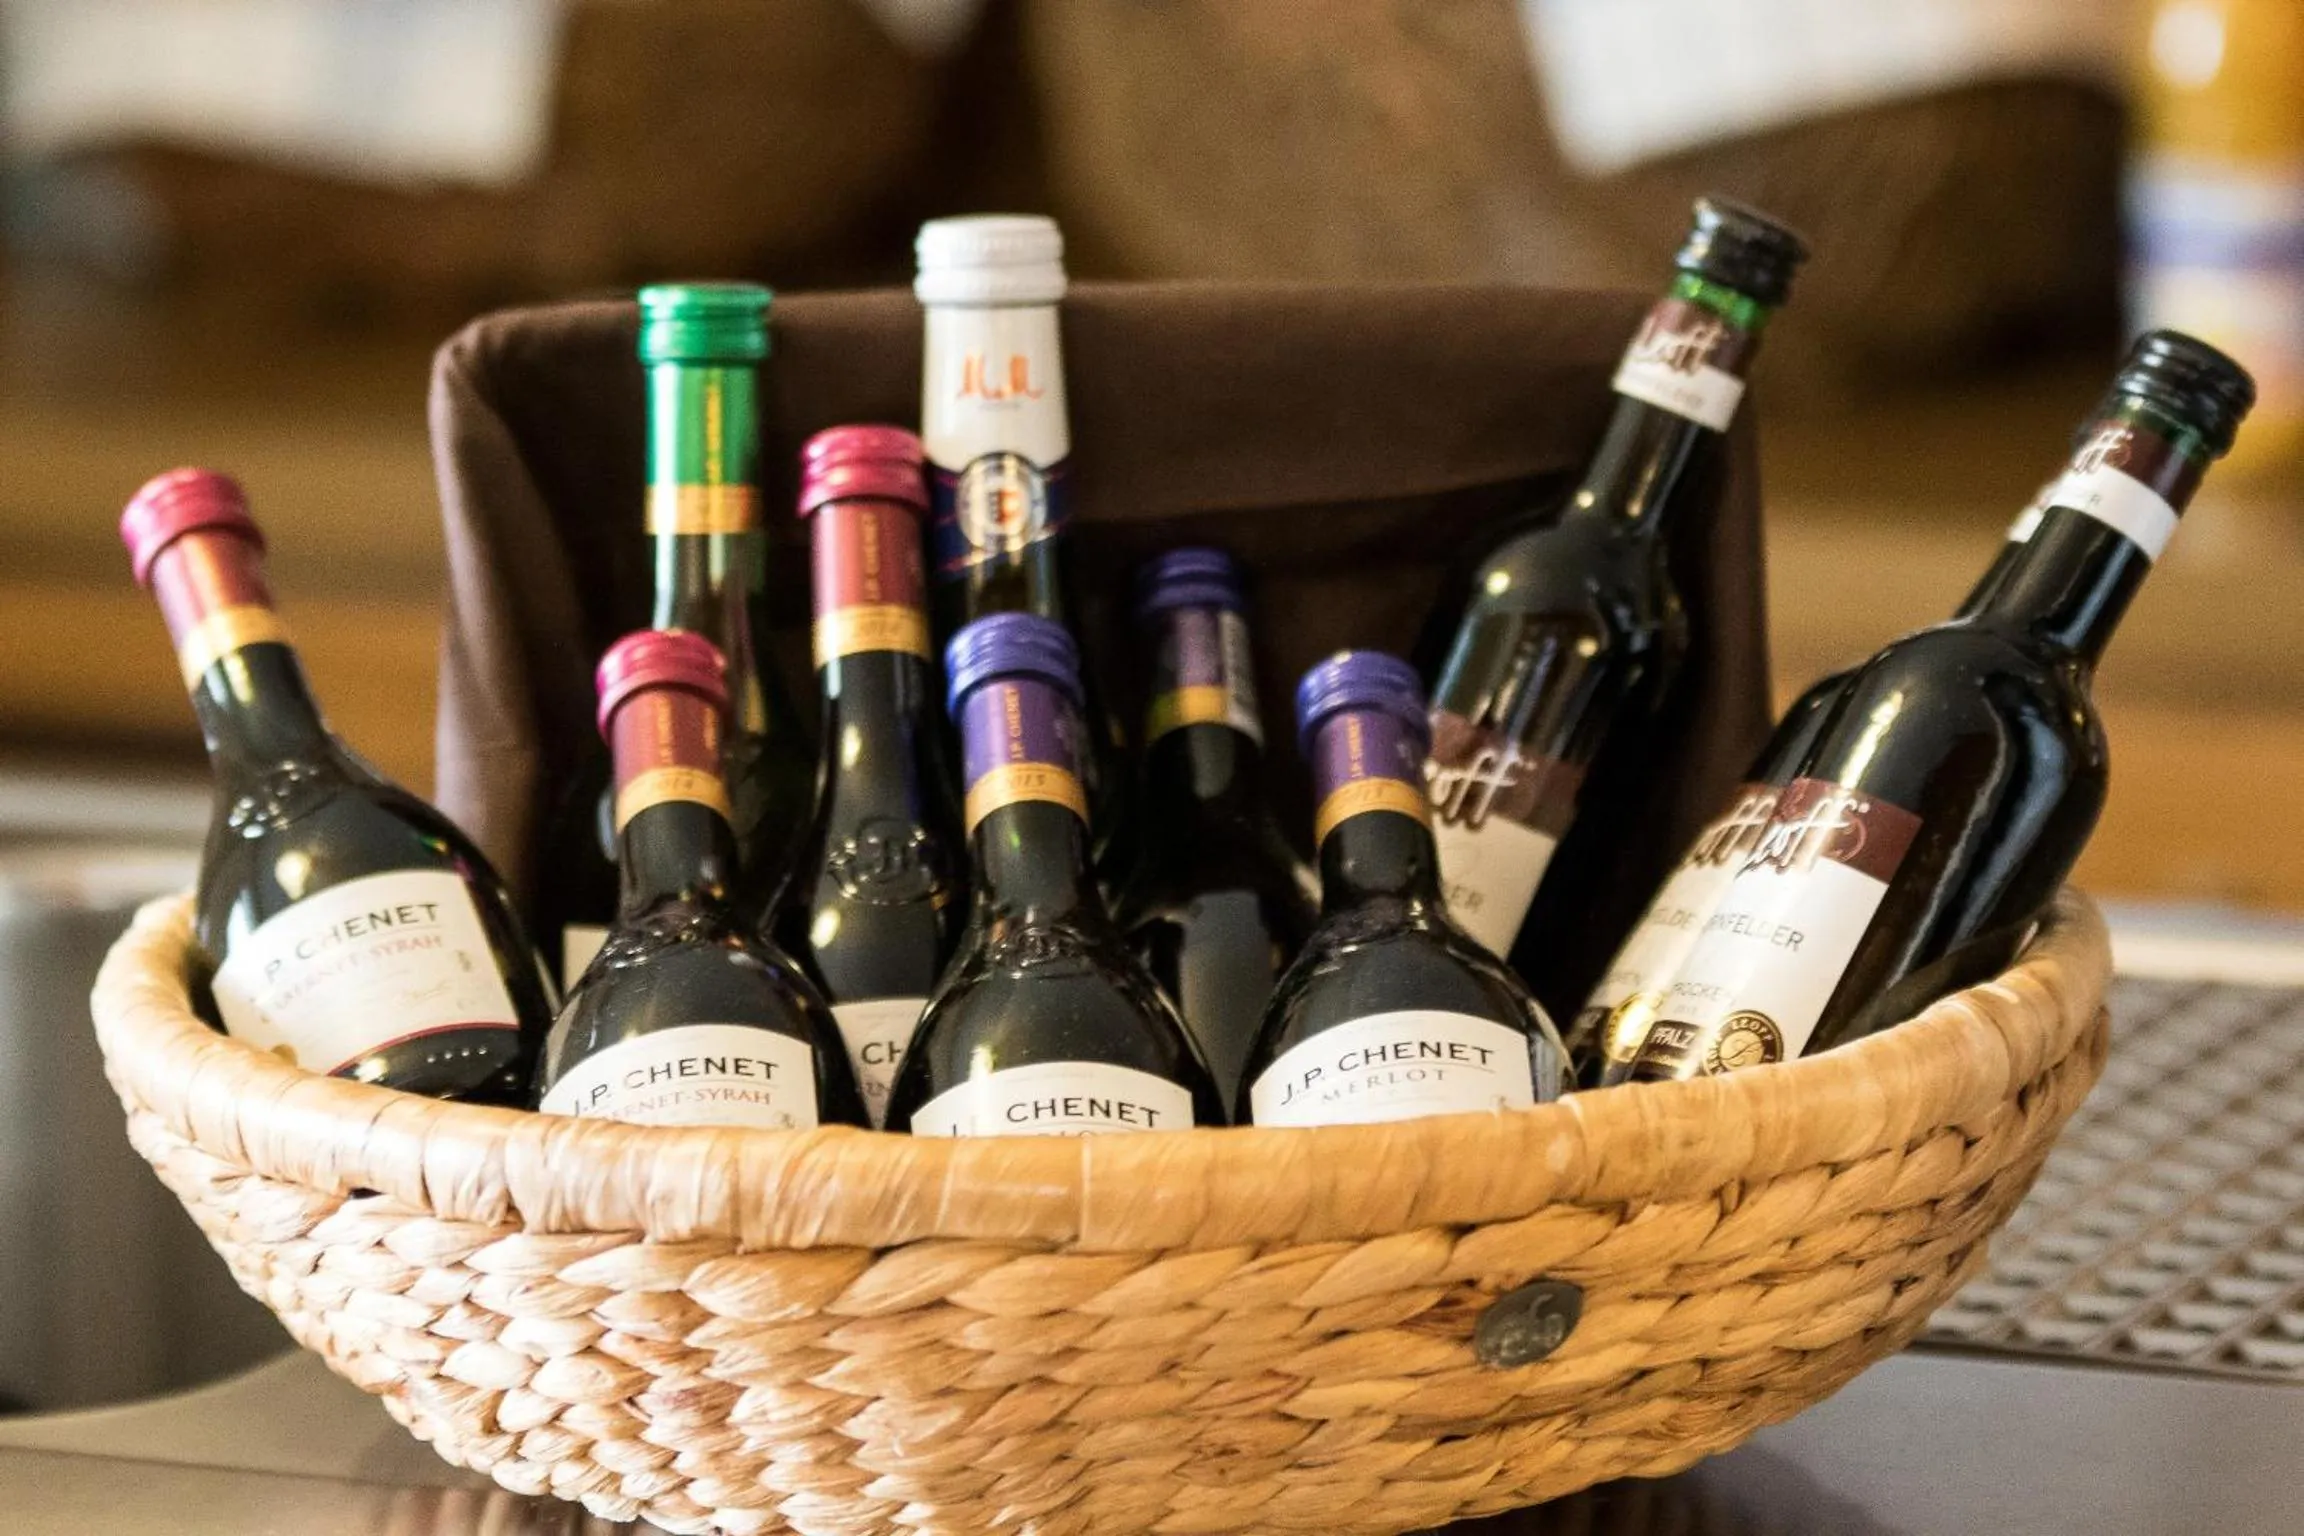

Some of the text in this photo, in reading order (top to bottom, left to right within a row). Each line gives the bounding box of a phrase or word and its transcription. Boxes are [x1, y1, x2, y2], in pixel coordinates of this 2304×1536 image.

[295, 902, 440, 961] CHENET
[622, 1056, 780, 1091] CHENET
[1280, 1041, 1496, 1106] J.P. CHENET
[1321, 1067, 1448, 1102] MERLOT
[1006, 1097, 1162, 1129] CHENET
